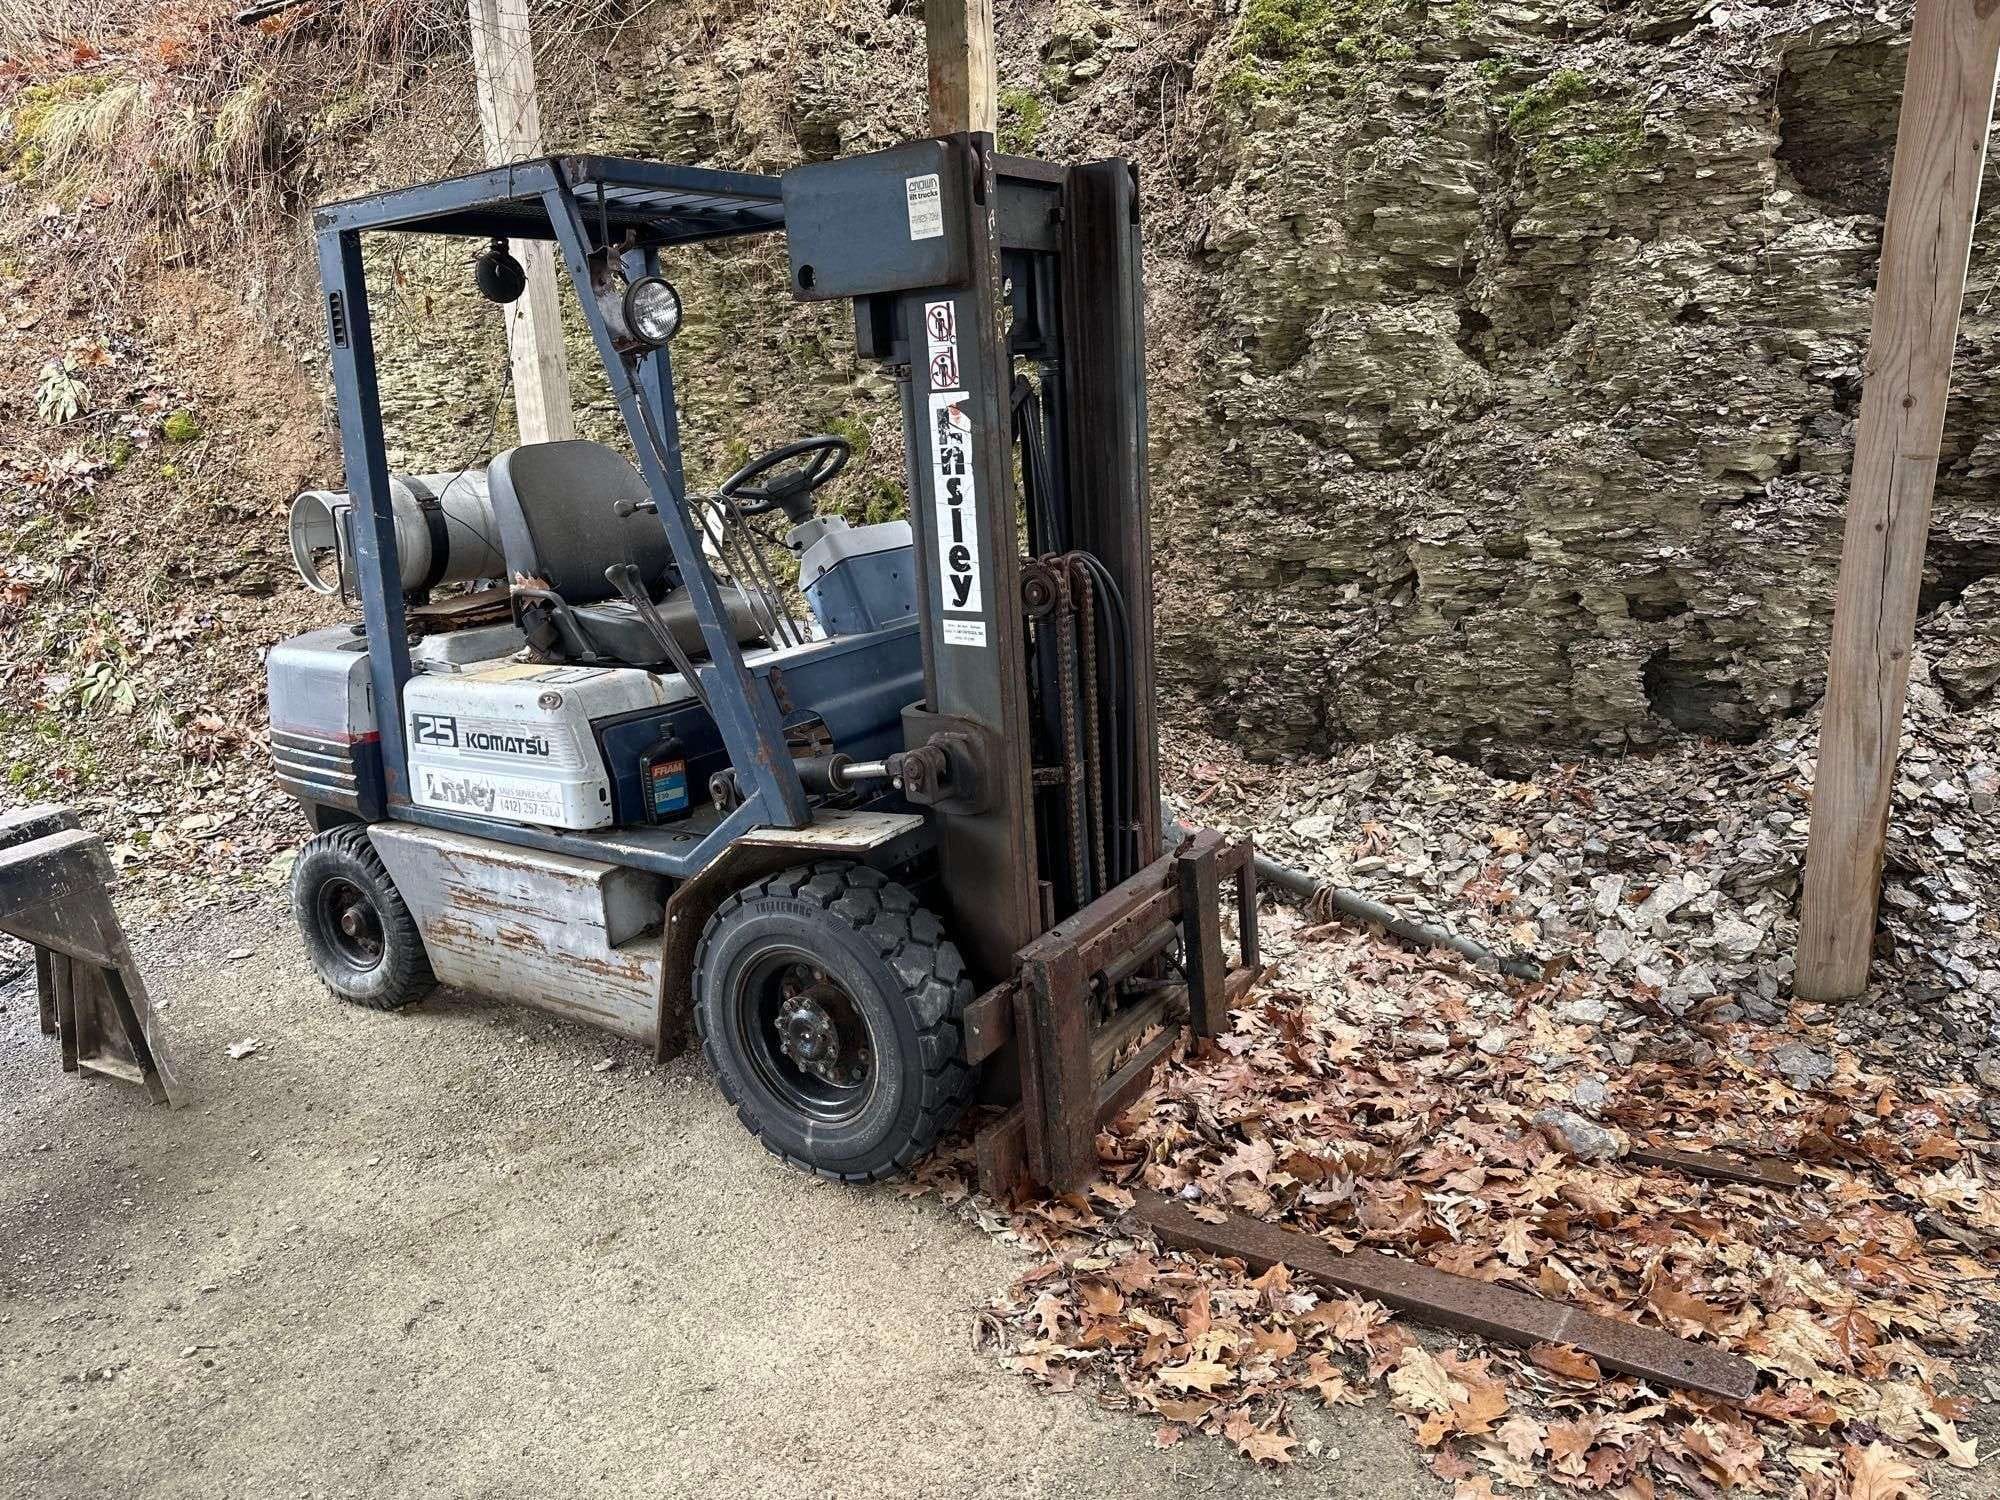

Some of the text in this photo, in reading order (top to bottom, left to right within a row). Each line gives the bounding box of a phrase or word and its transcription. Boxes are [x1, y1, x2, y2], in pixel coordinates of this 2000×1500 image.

[918, 189, 938, 199] trucks
[417, 715, 456, 747] 25
[465, 732, 550, 757] KOMATSU
[654, 760, 683, 777] FRAM
[499, 799, 521, 814] (412)
